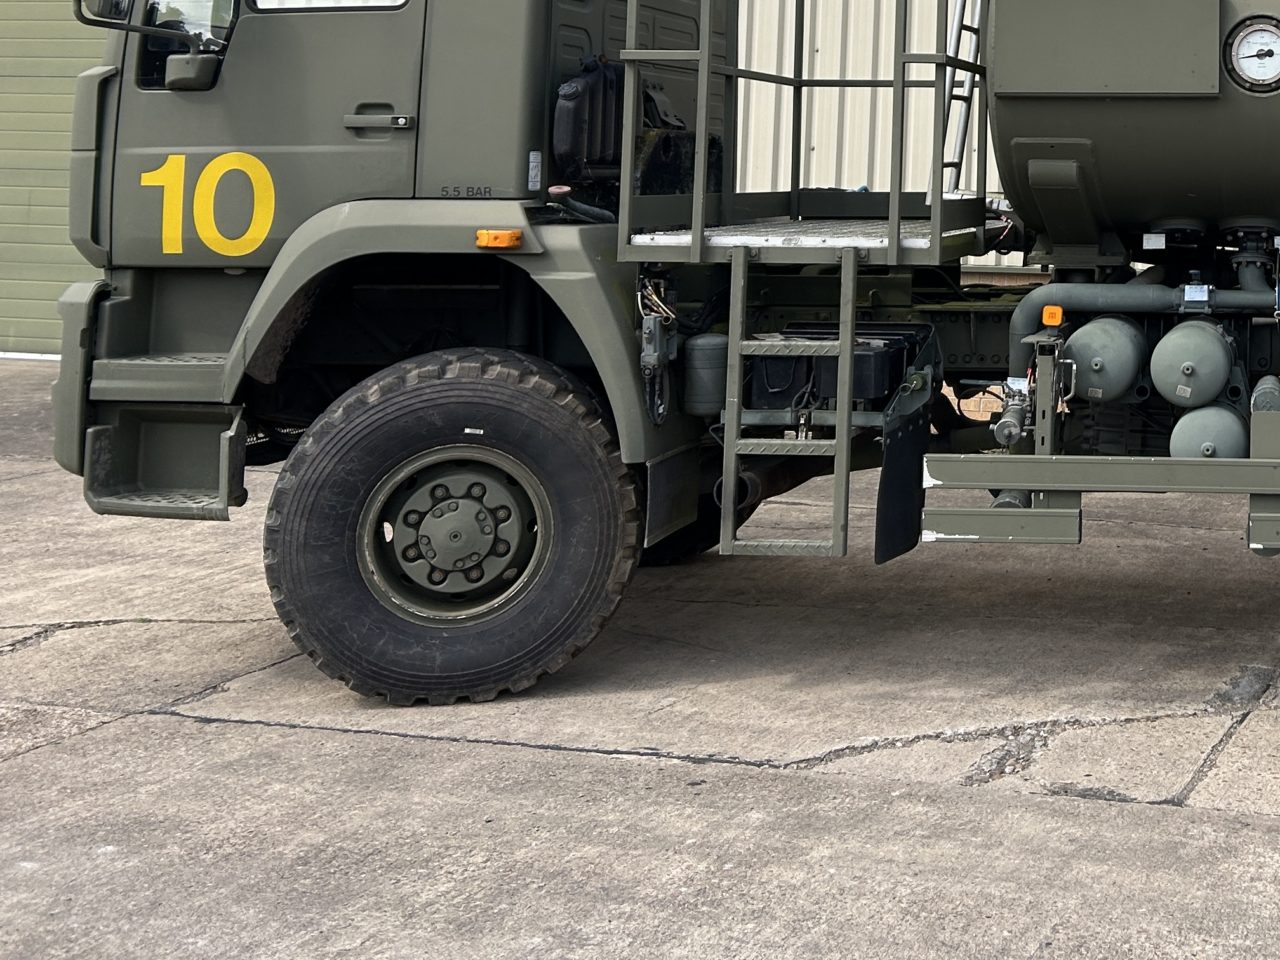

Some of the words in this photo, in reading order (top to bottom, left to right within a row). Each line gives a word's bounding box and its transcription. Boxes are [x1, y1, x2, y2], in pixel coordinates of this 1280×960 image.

[139, 151, 276, 258] 10
[440, 185, 462, 197] 5.5
[465, 186, 493, 197] BAR
